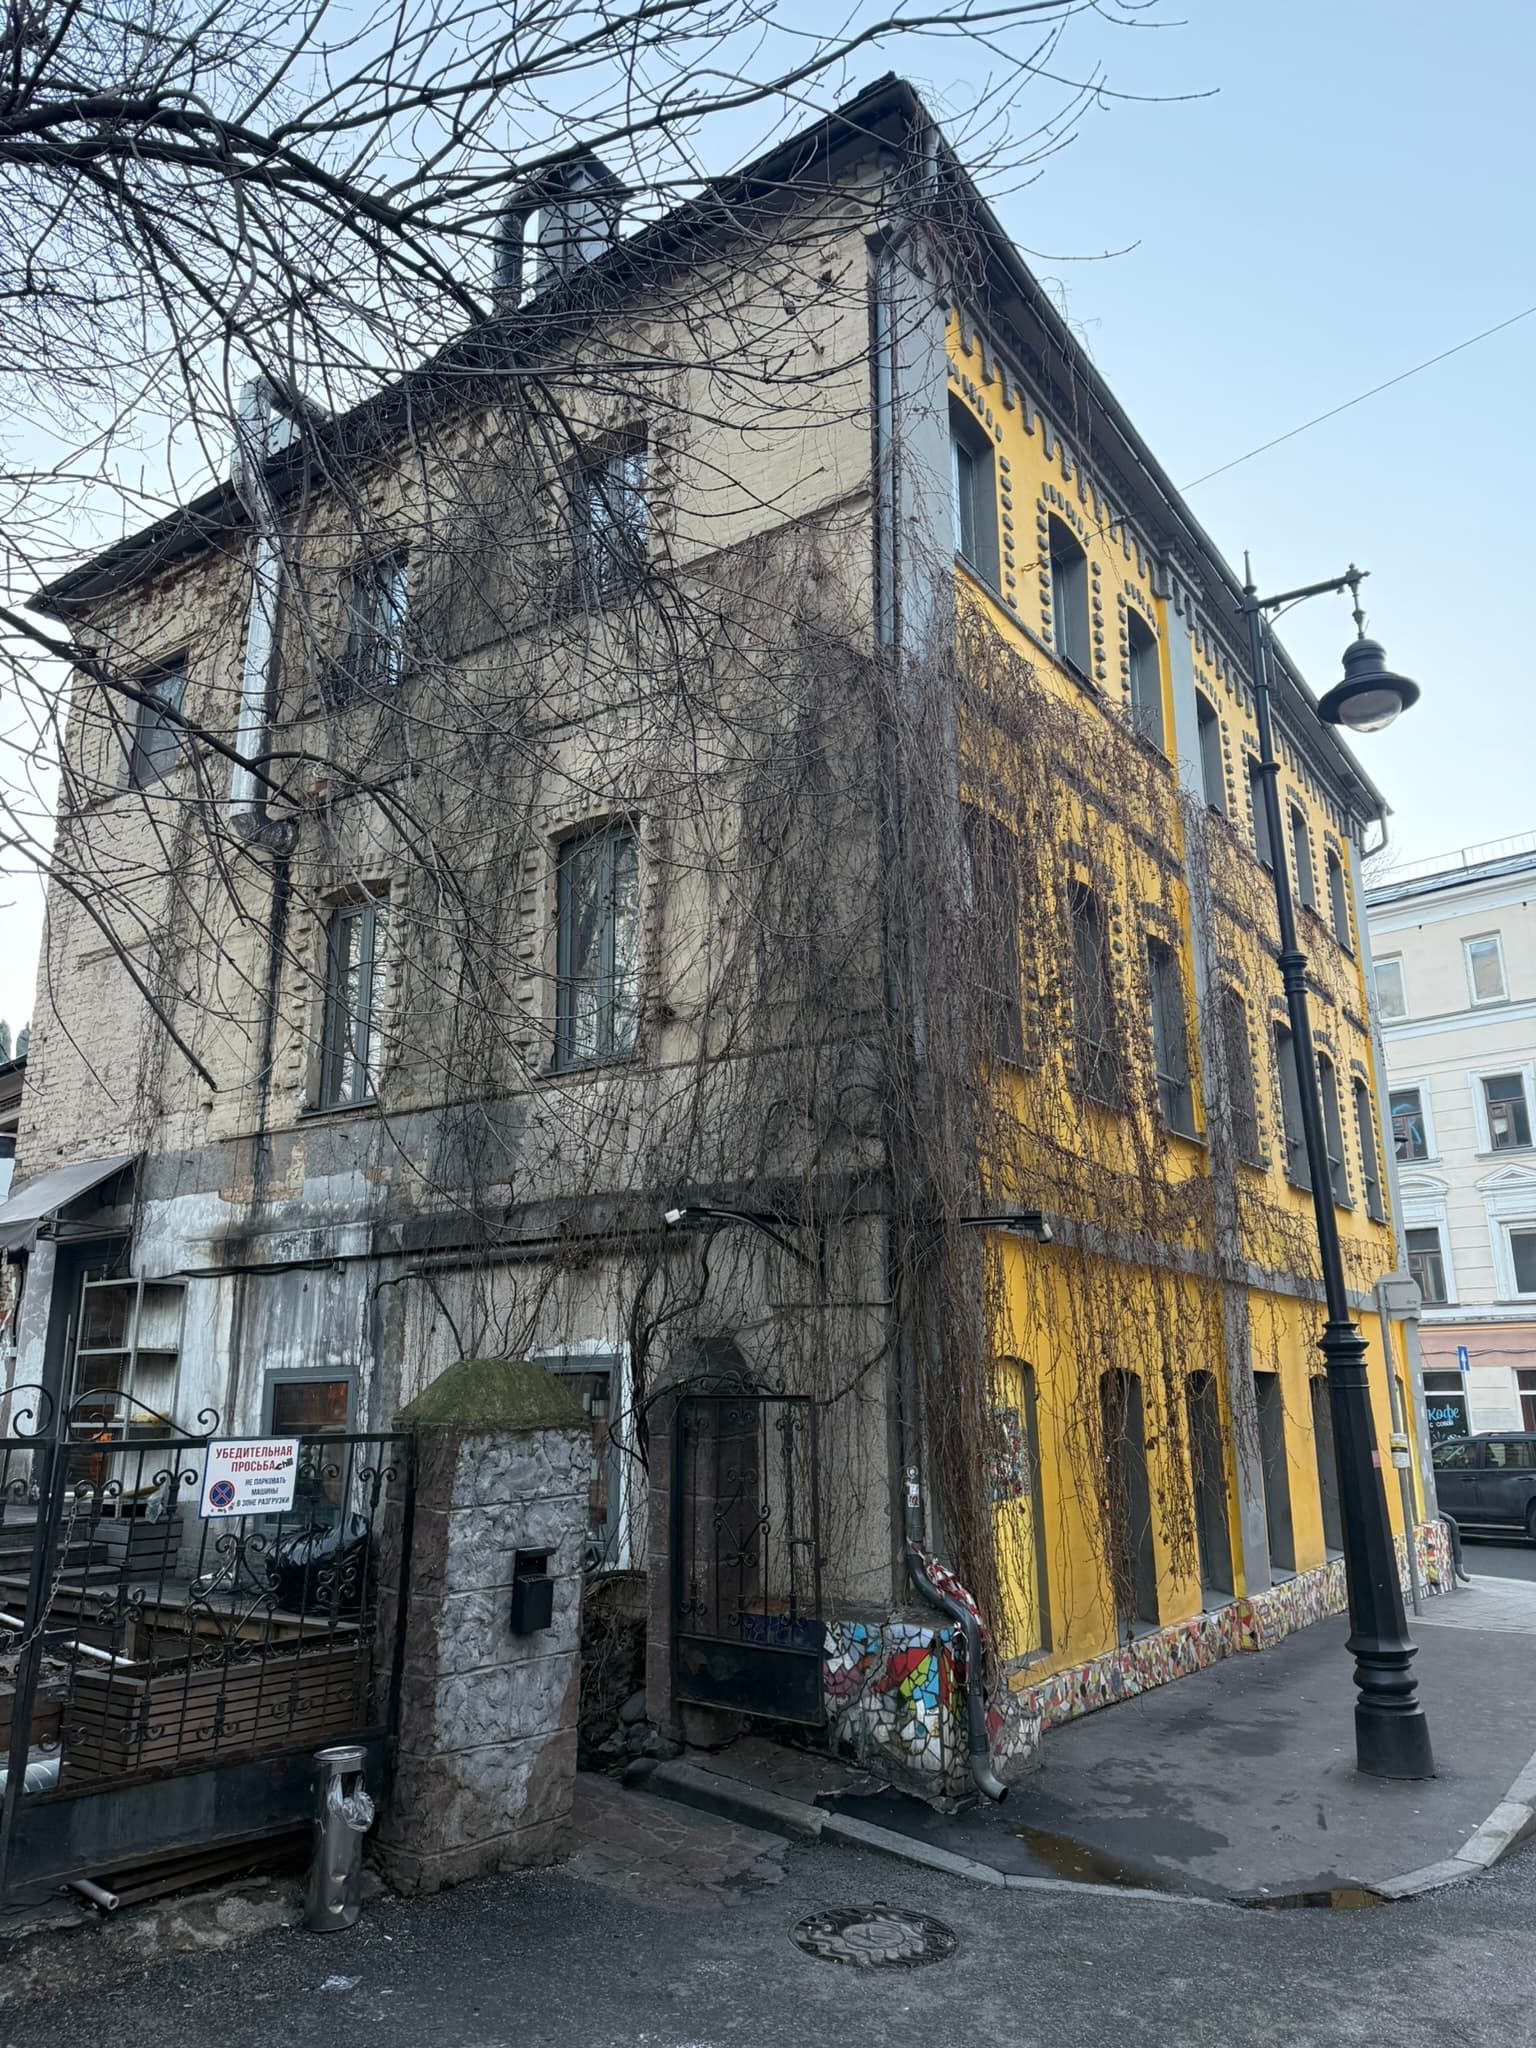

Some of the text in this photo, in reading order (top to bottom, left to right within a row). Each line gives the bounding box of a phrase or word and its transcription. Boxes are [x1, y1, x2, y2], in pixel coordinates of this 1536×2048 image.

[216, 1446, 293, 1459] УБЕДИТЕЛЬНАЯ
[231, 1460, 275, 1472] ПРОСЬБА
[245, 1478, 252, 1486] НЕ
